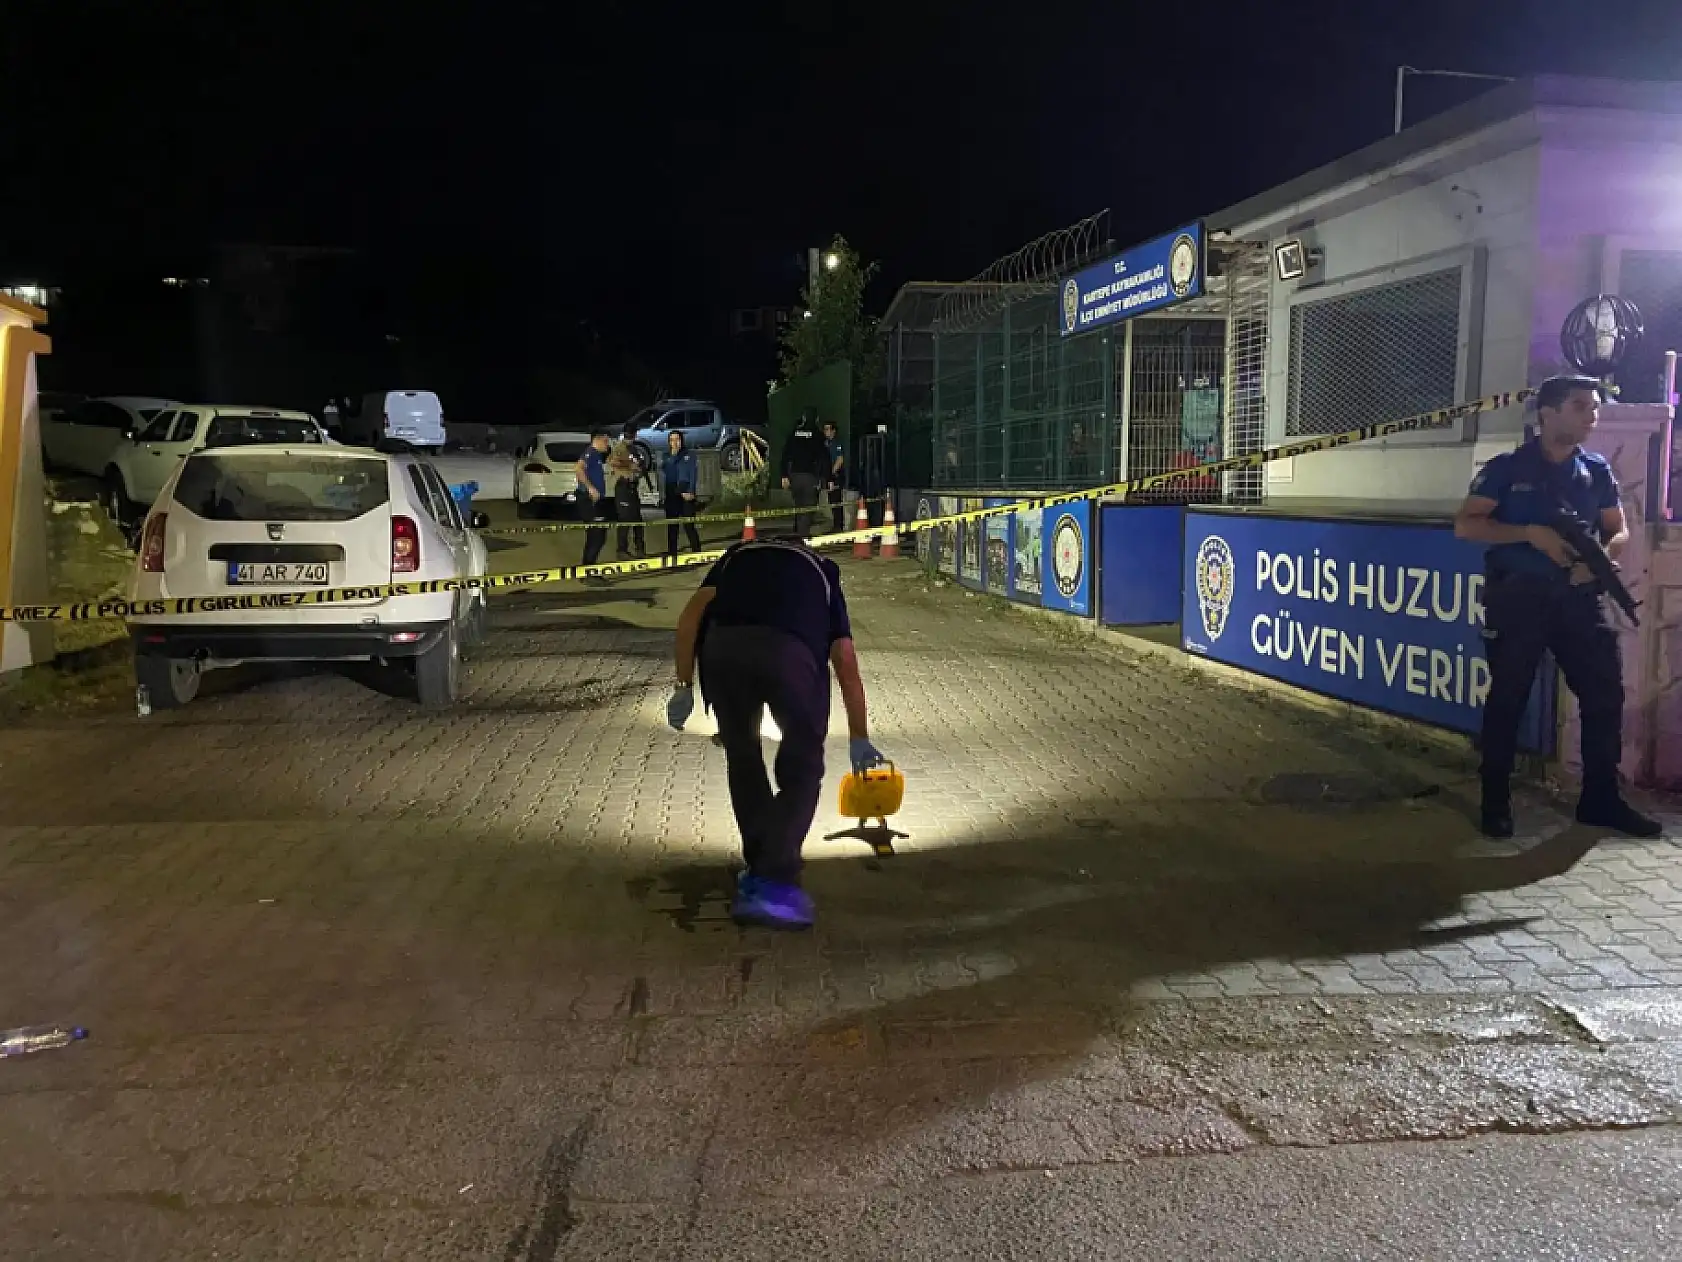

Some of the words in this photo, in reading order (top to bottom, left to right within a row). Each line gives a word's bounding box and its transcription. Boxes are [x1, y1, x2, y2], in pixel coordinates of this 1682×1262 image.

[238, 564, 254, 580] 41
[262, 564, 288, 581] AR
[293, 564, 325, 581] 740
[1256, 547, 1340, 604] POLİS
[1348, 561, 1486, 626] HUZUR
[1250, 610, 1366, 680] GÜVEN
[1376, 638, 1493, 708] VERİR
